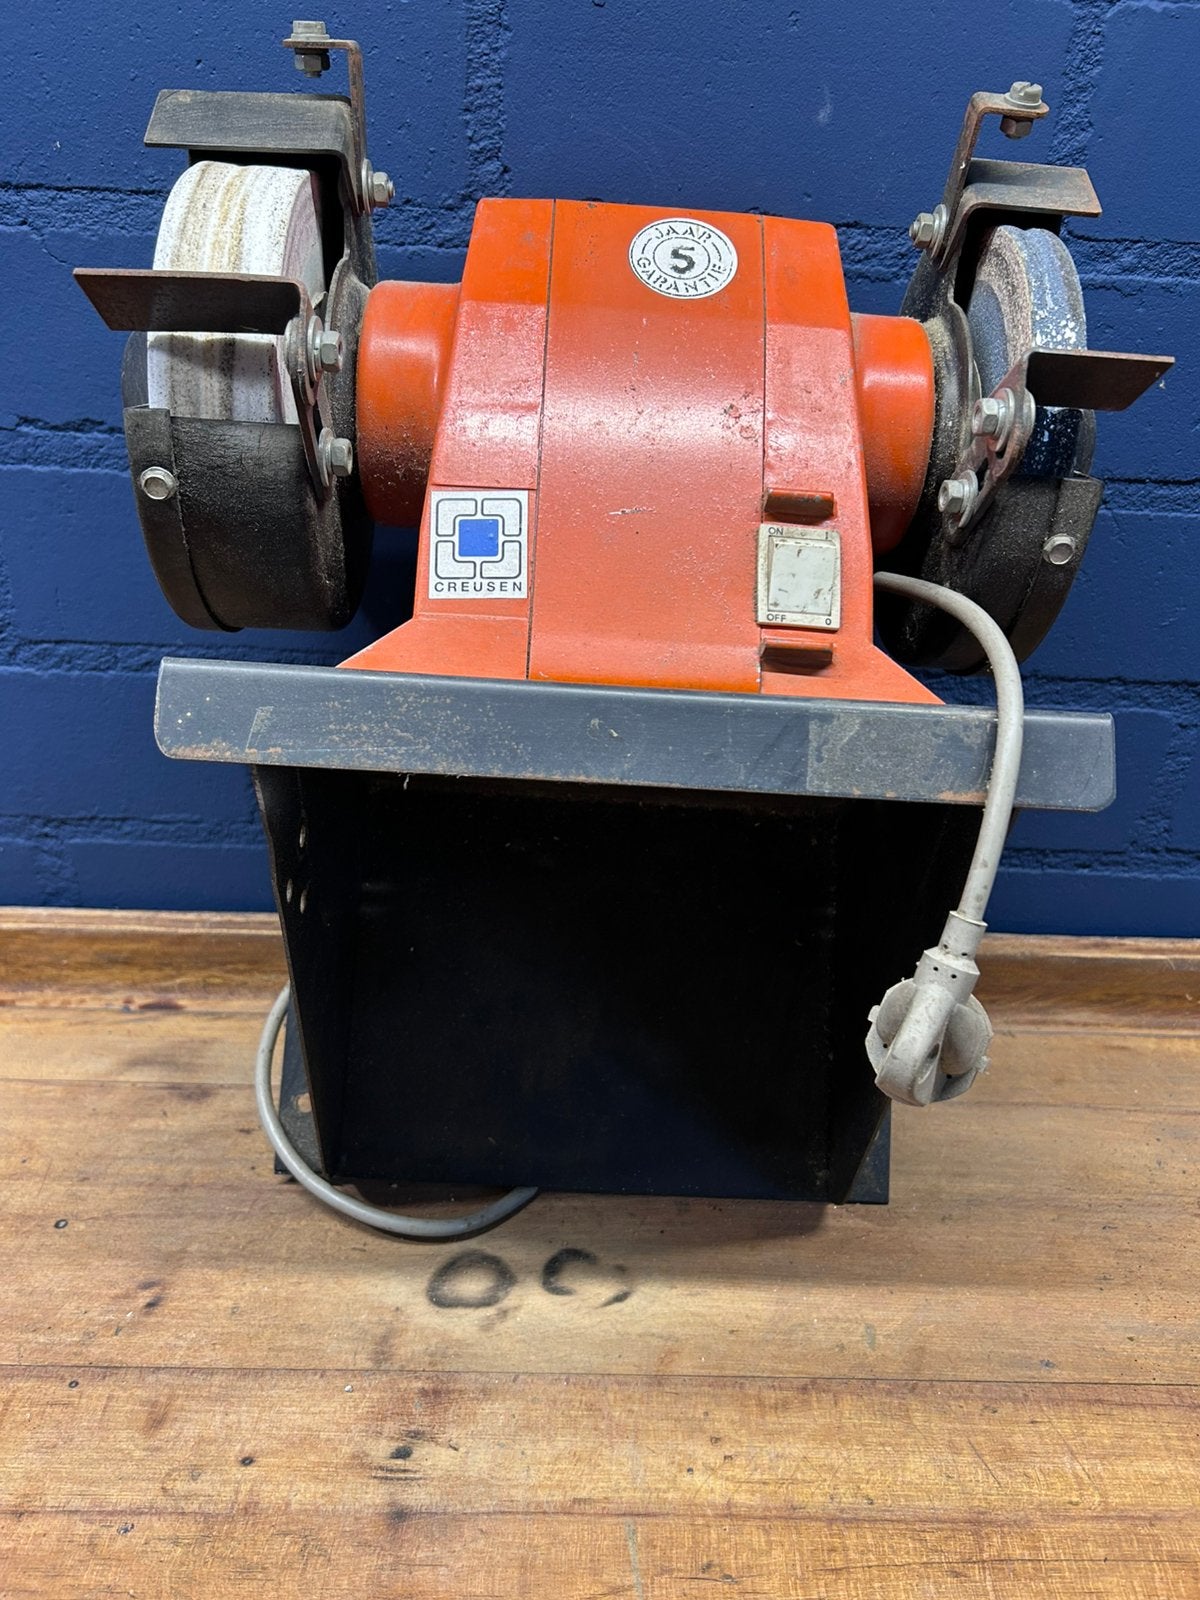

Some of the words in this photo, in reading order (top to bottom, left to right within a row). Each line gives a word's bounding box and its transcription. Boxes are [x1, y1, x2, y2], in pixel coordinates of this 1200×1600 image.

[670, 245, 696, 274] 5
[637, 257, 727, 293] GARANTIE
[768, 526, 784, 536] ON
[434, 581, 523, 592] CREUSEN
[767, 613, 787, 622] OFF
